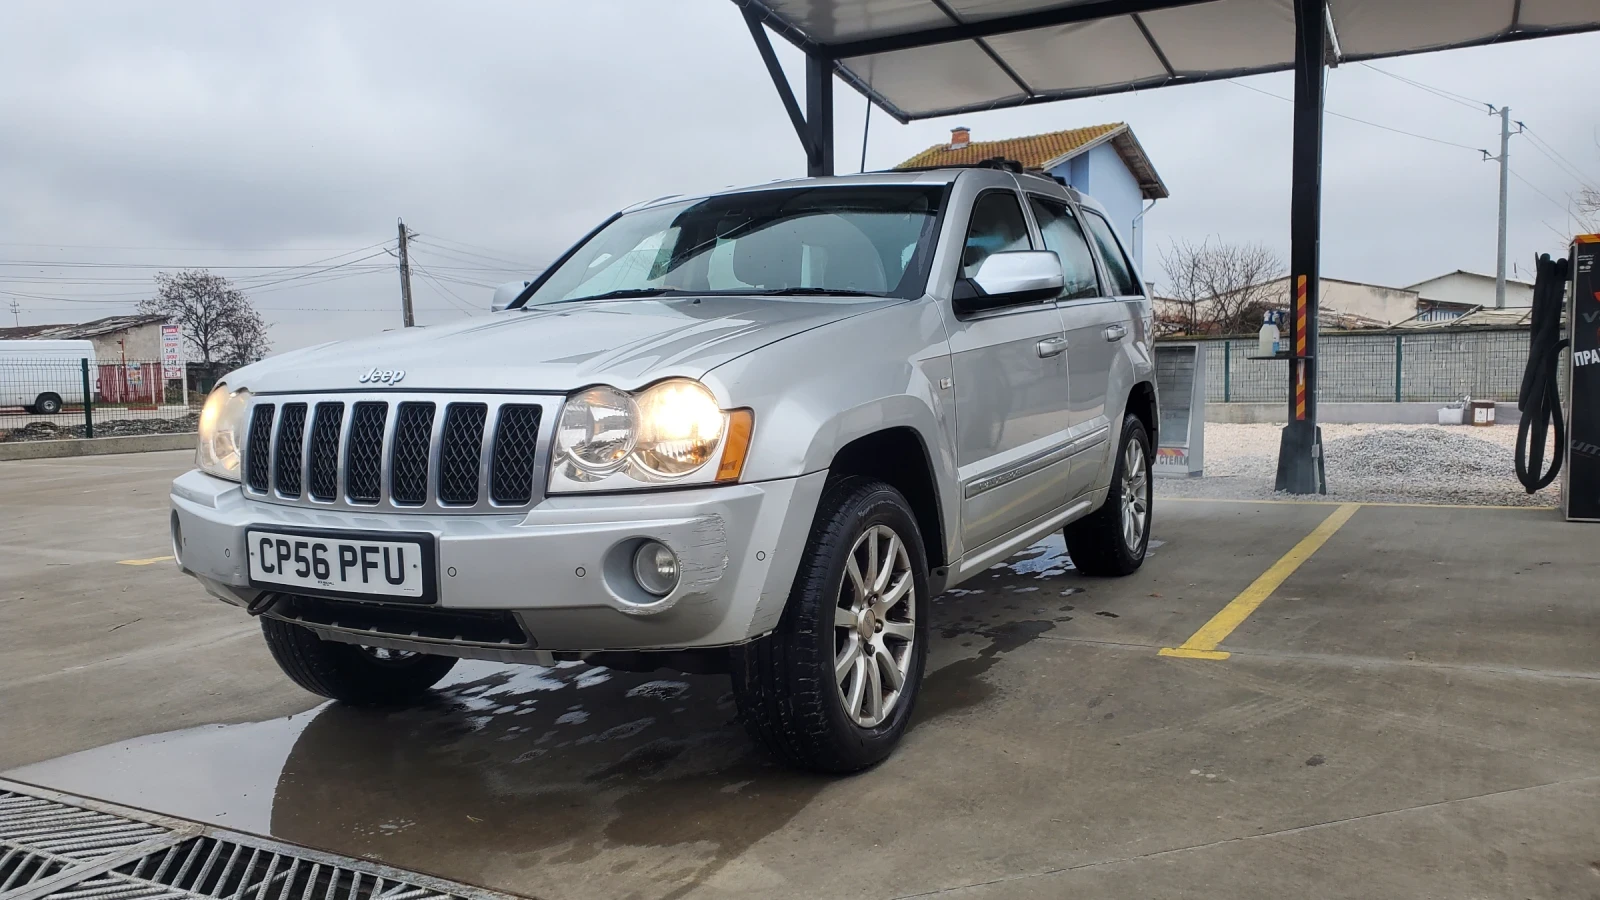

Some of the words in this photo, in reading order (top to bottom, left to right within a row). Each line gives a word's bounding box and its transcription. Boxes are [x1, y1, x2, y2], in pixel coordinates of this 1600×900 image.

[1574, 348, 1600, 366] ПРА
[359, 367, 406, 386] Jeep
[259, 537, 331, 580] CP56
[338, 544, 405, 585] PFU
